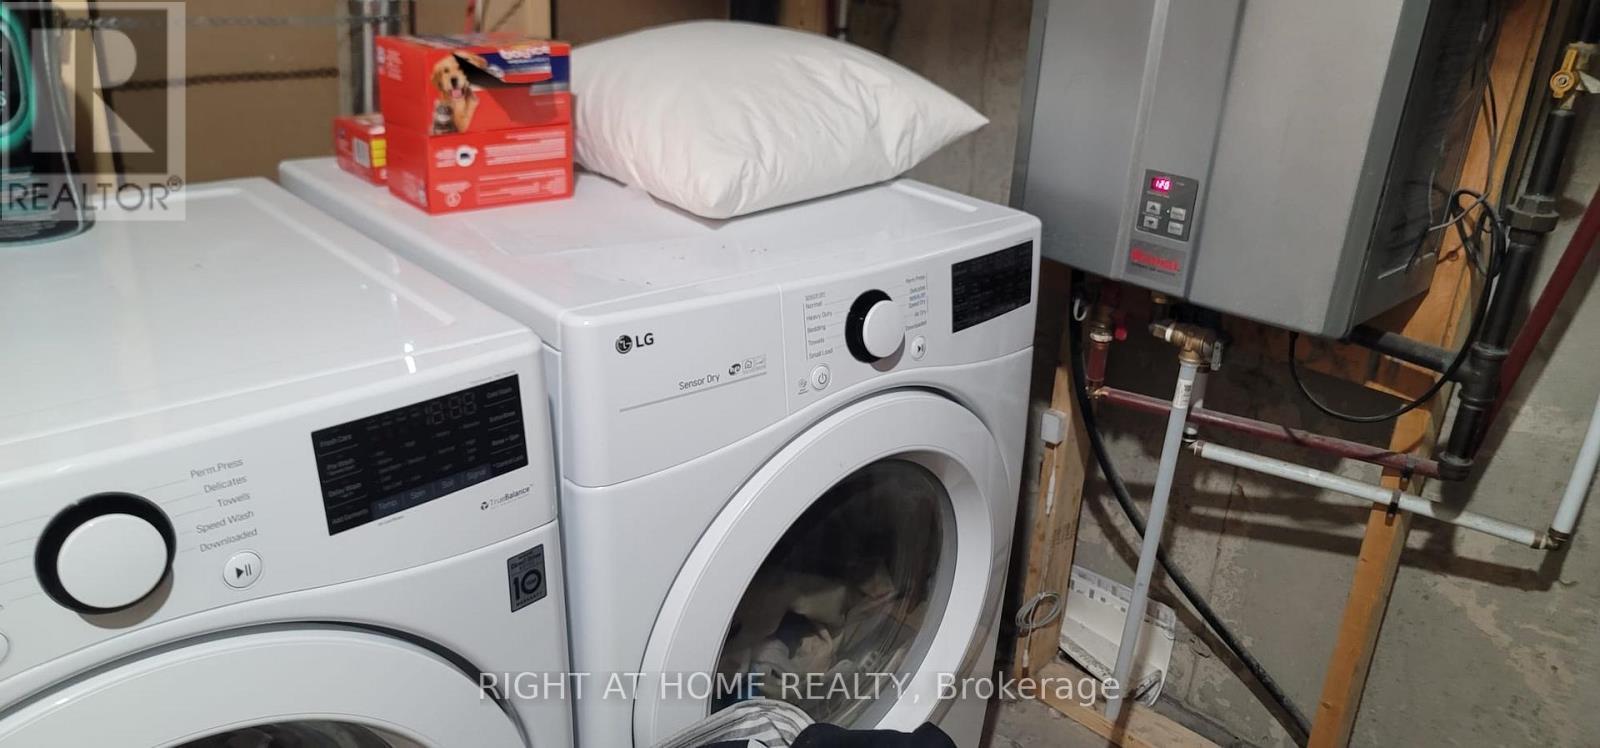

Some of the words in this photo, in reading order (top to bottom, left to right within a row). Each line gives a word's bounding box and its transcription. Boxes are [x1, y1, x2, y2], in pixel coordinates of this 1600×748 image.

[635, 332, 655, 348] LG
[678, 377, 705, 391] Sensor
[706, 372, 721, 384] Dry
[190, 458, 244, 479] Perm.Press
[203, 475, 248, 494] Delicates
[217, 492, 250, 507] Towels
[196, 517, 226, 534] Speed
[226, 510, 254, 525] Wash
[199, 527, 258, 553] Downloaded
